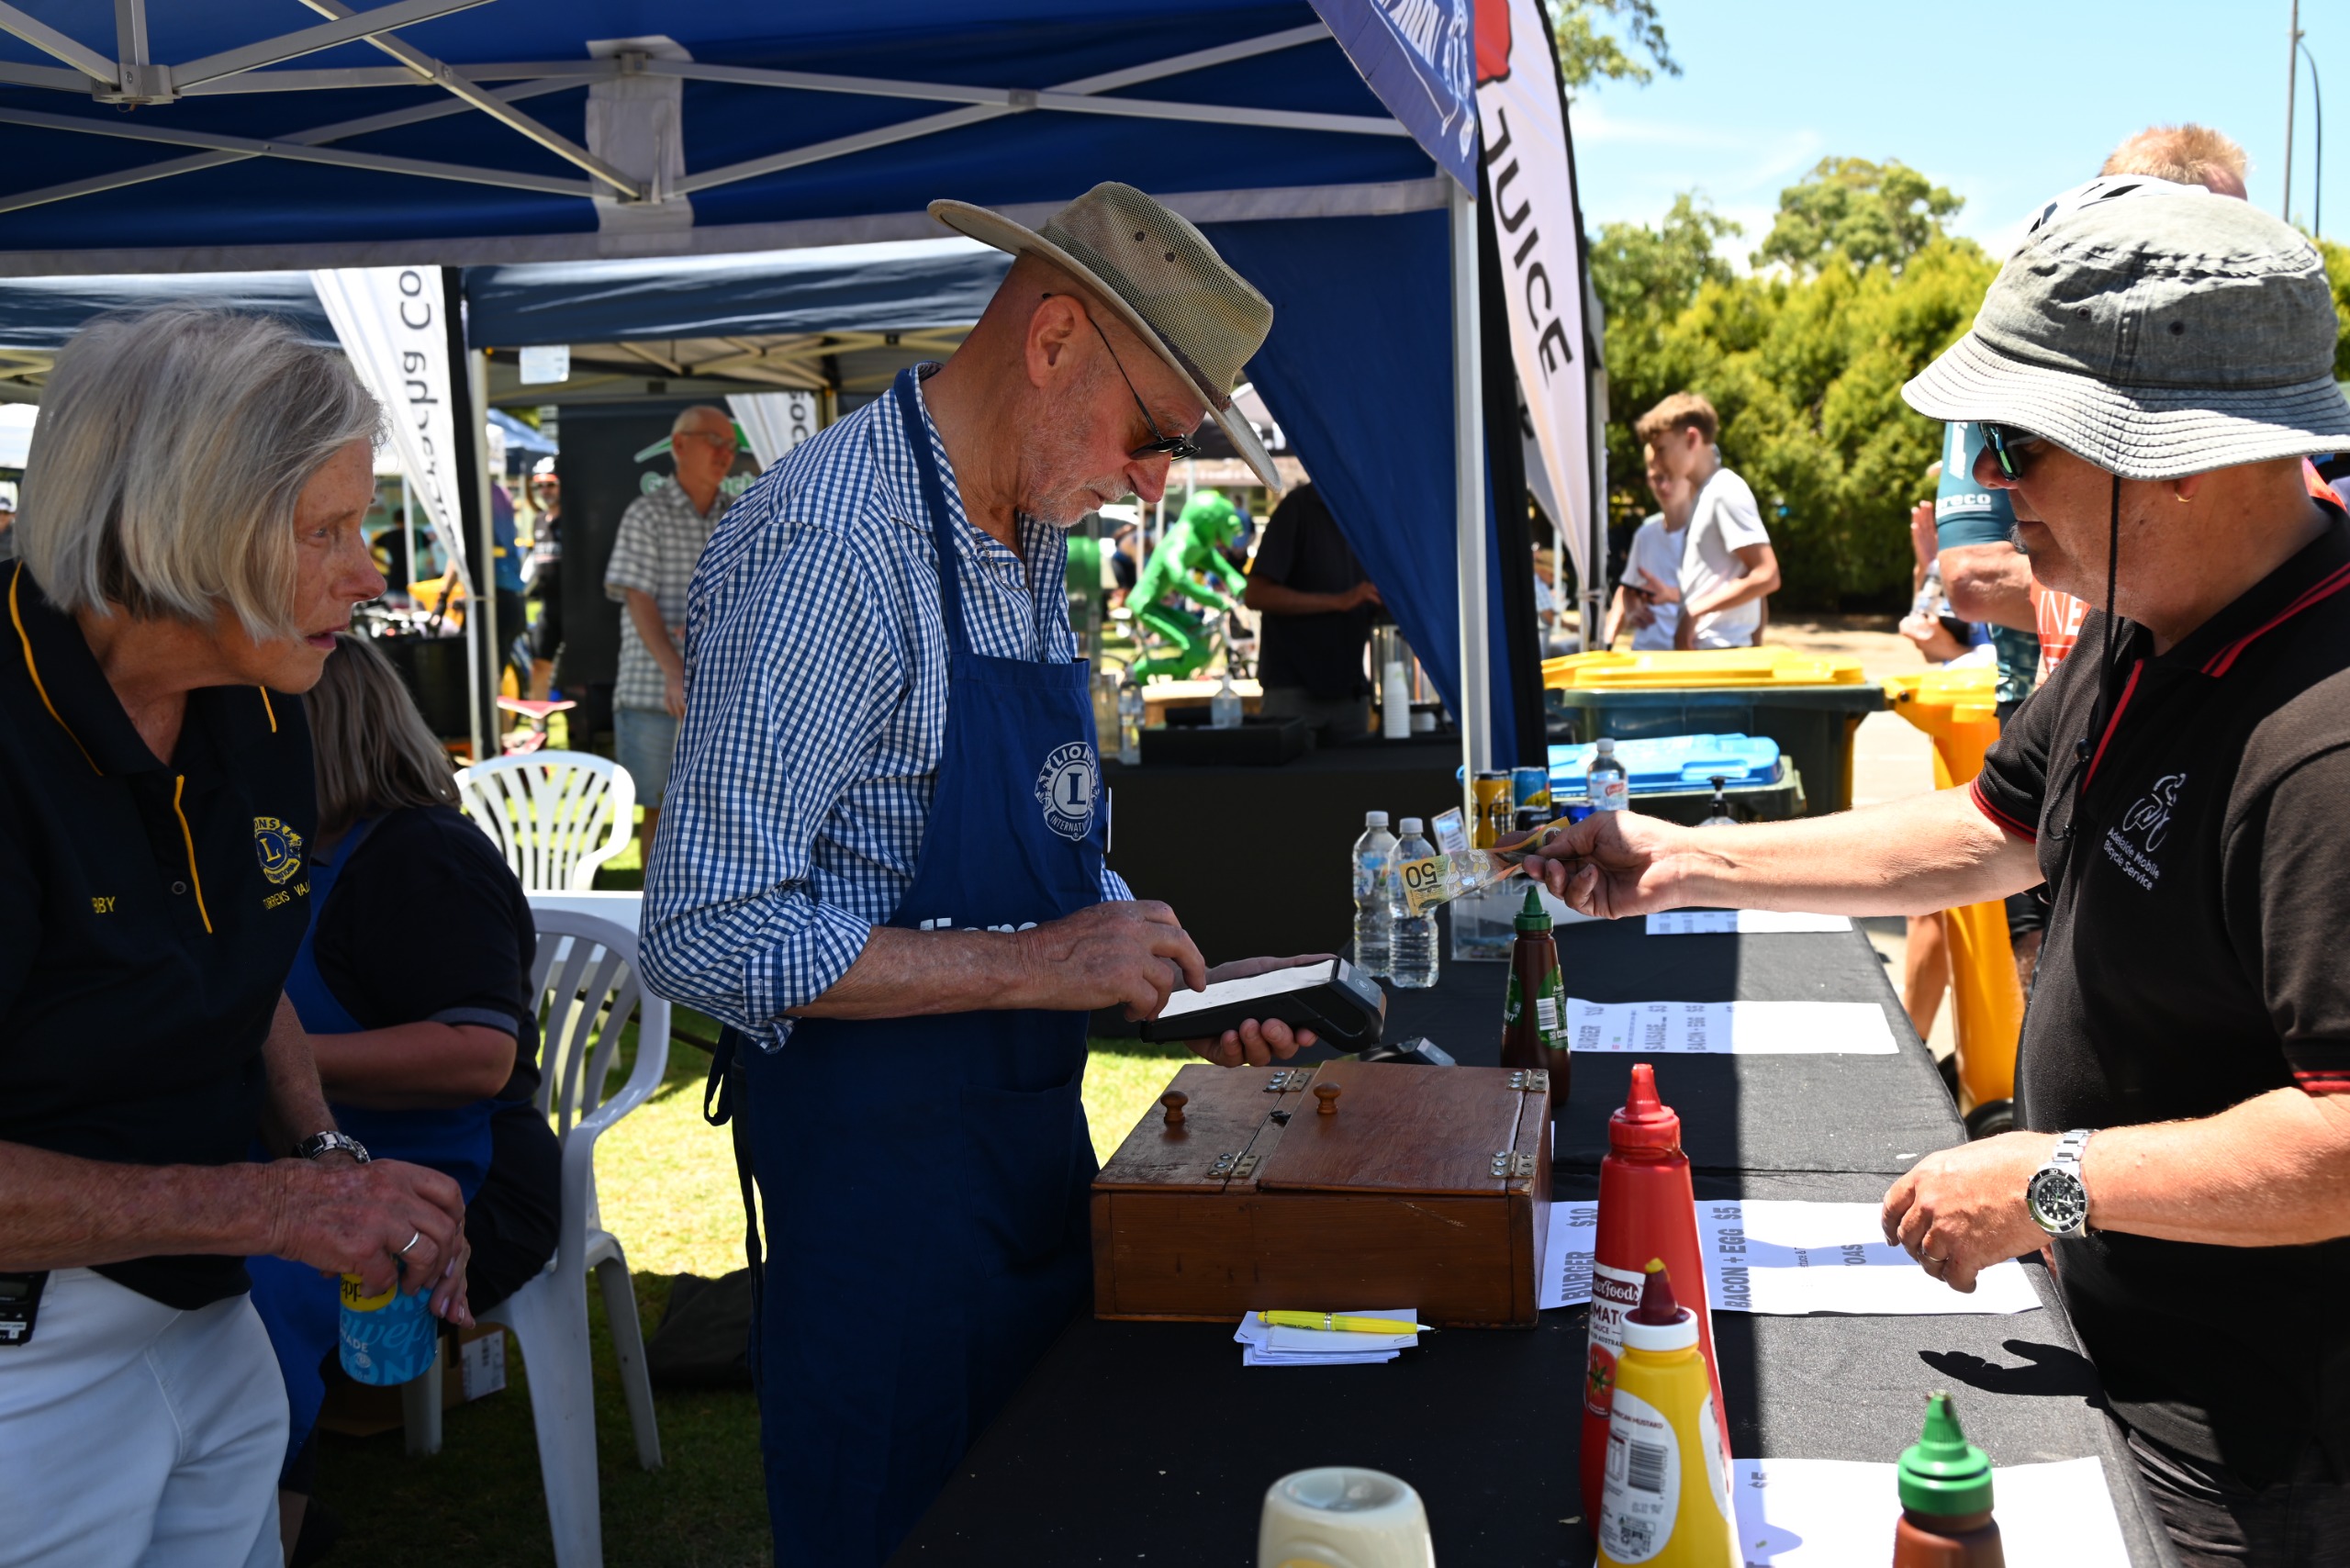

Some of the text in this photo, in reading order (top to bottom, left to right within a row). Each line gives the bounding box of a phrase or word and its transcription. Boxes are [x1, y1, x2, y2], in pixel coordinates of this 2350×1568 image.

[1487, 106, 1573, 389] JUICE
[1067, 772, 1086, 805] L
[260, 837, 281, 862] L
[2103, 839, 2153, 890] Bicycle Service
[2107, 826, 2160, 879] Adelaide Mobile
[1405, 862, 1438, 889] 50
[1710, 1206, 1742, 1220] $5
[1561, 1207, 1598, 1302] BURGER $10
[1718, 1228, 1747, 1254] EGG
[1840, 1244, 1867, 1267] OAS
[1721, 1267, 1752, 1308] BACON
[1590, 1302, 1624, 1326] MAT
